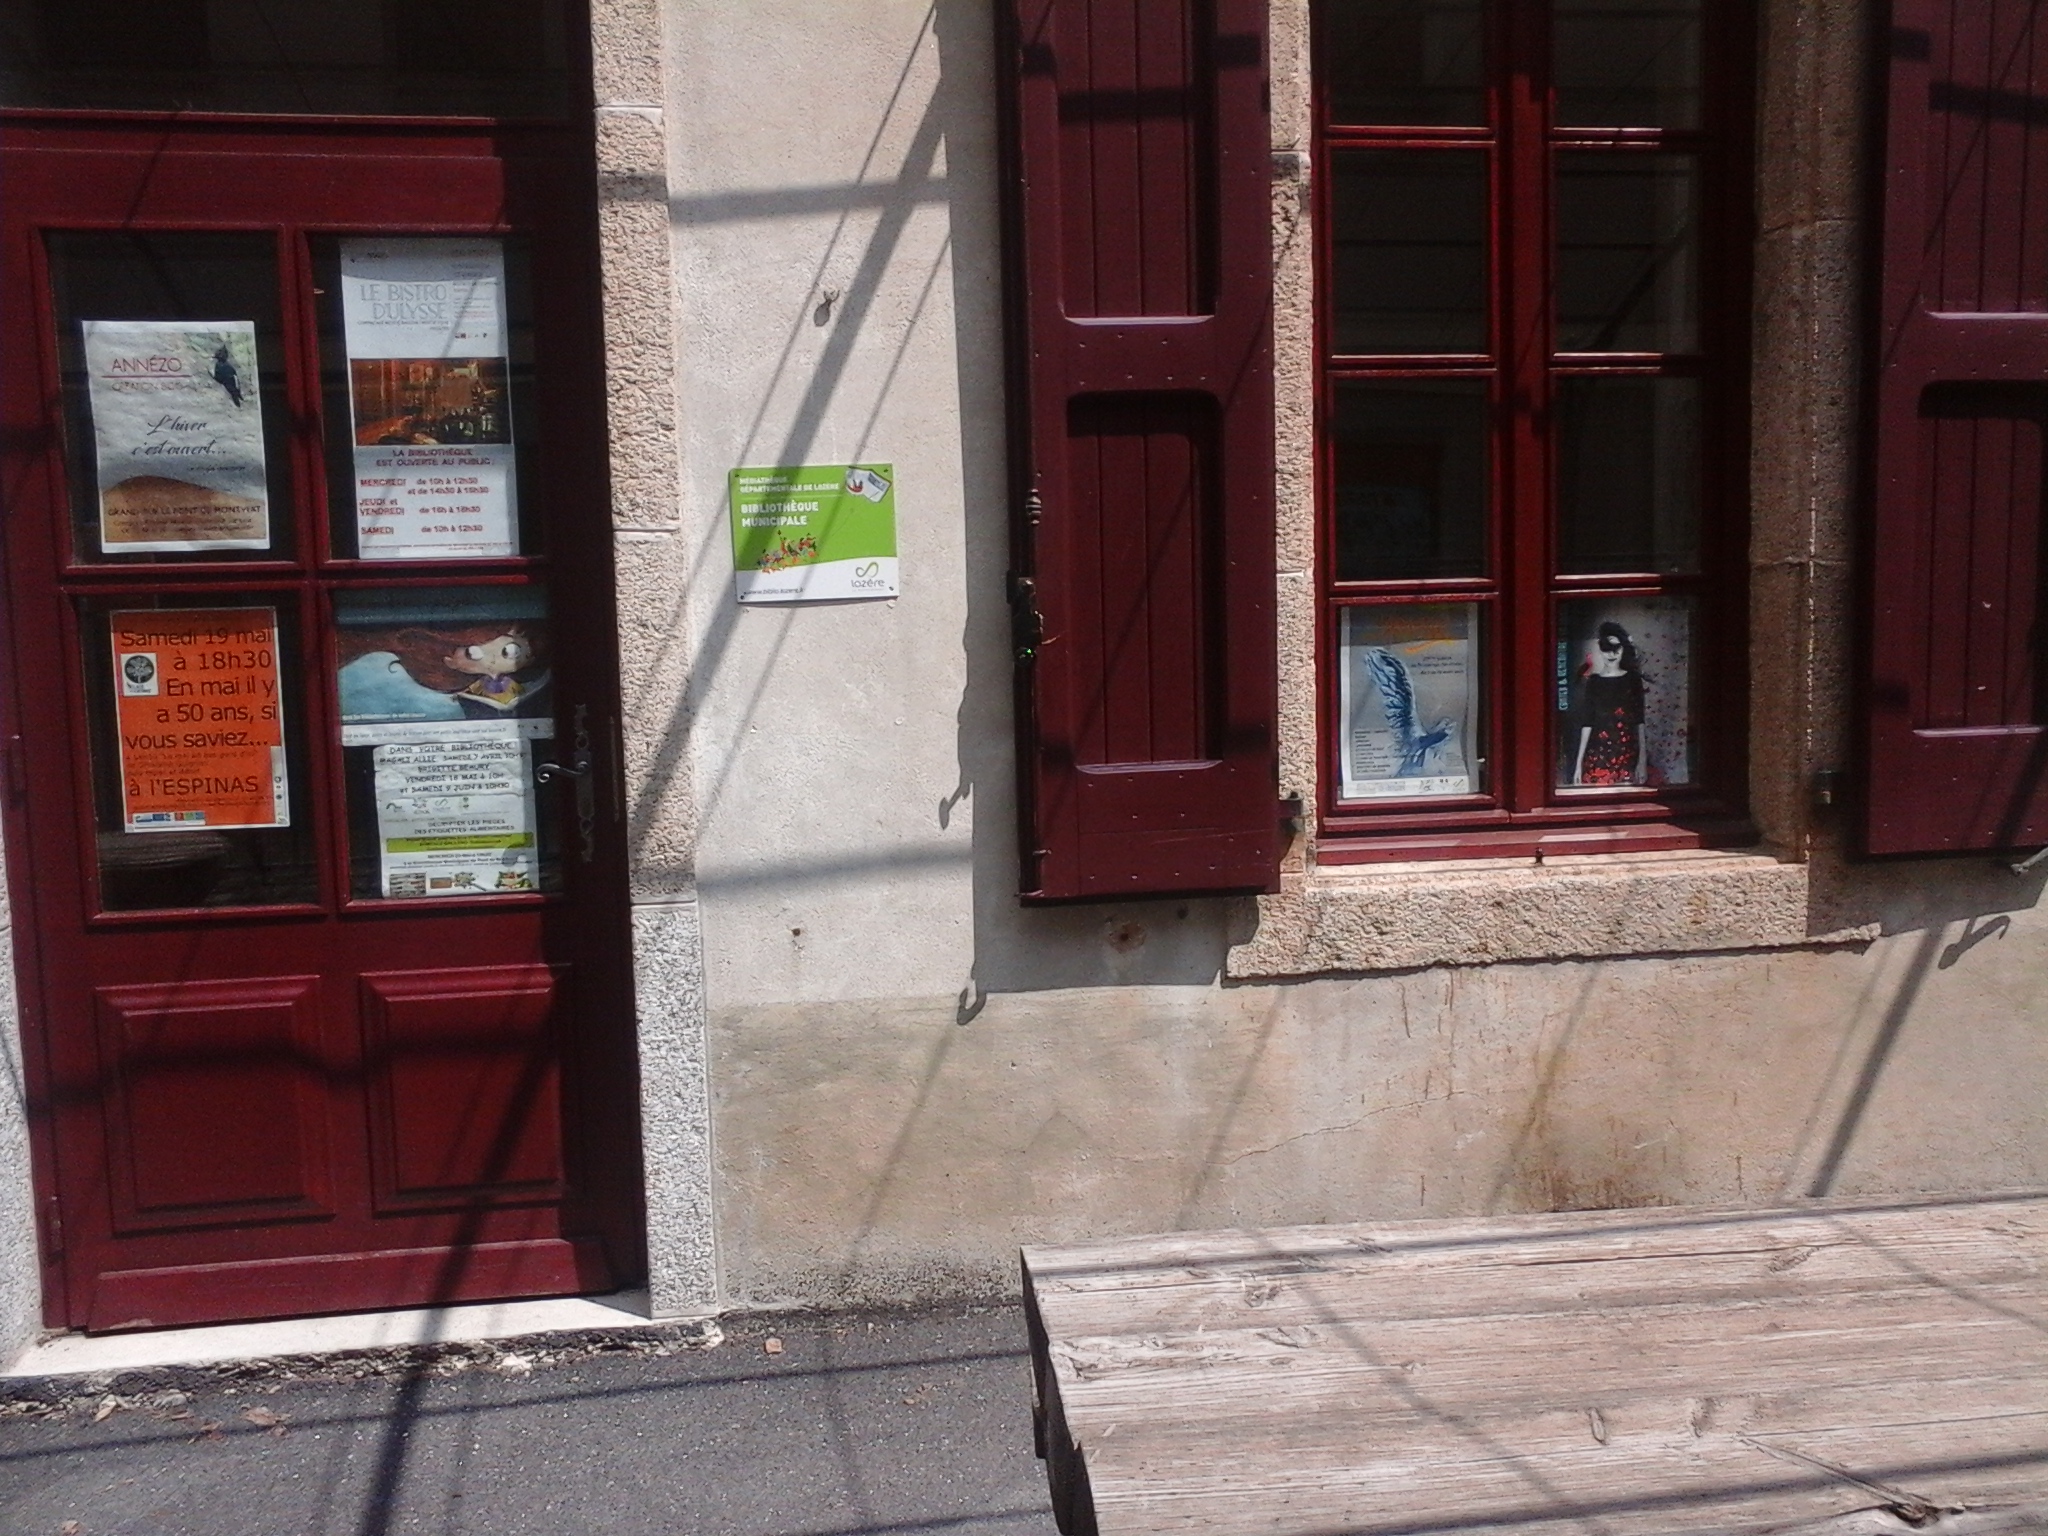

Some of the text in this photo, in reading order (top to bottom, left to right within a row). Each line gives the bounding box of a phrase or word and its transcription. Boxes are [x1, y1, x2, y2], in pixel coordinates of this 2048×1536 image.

[359, 284, 447, 301] LE BISTRO
[112, 354, 183, 373] ANNÉZO
[376, 459, 393, 467] EST
[396, 458, 439, 466] OUVERTE
[441, 458, 454, 466] AU
[360, 479, 407, 487] MERCREDI
[360, 508, 405, 516] VENDREDI
[741, 500, 819, 514] BIBLIOTHÈQUE
[741, 515, 807, 527] MUNICIPALE
[361, 526, 394, 535] SAMEDI
[120, 628, 271, 646] Samedi 19 mai
[173, 649, 271, 670] à 18h30
[166, 678, 193, 697] En
[201, 677, 239, 695] mai
[247, 675, 256, 694] il
[262, 679, 275, 697] y
[156, 701, 277, 724] a 50 ans, si
[125, 729, 268, 749] vous saviez...
[129, 776, 258, 796] à l'ESPINAS
